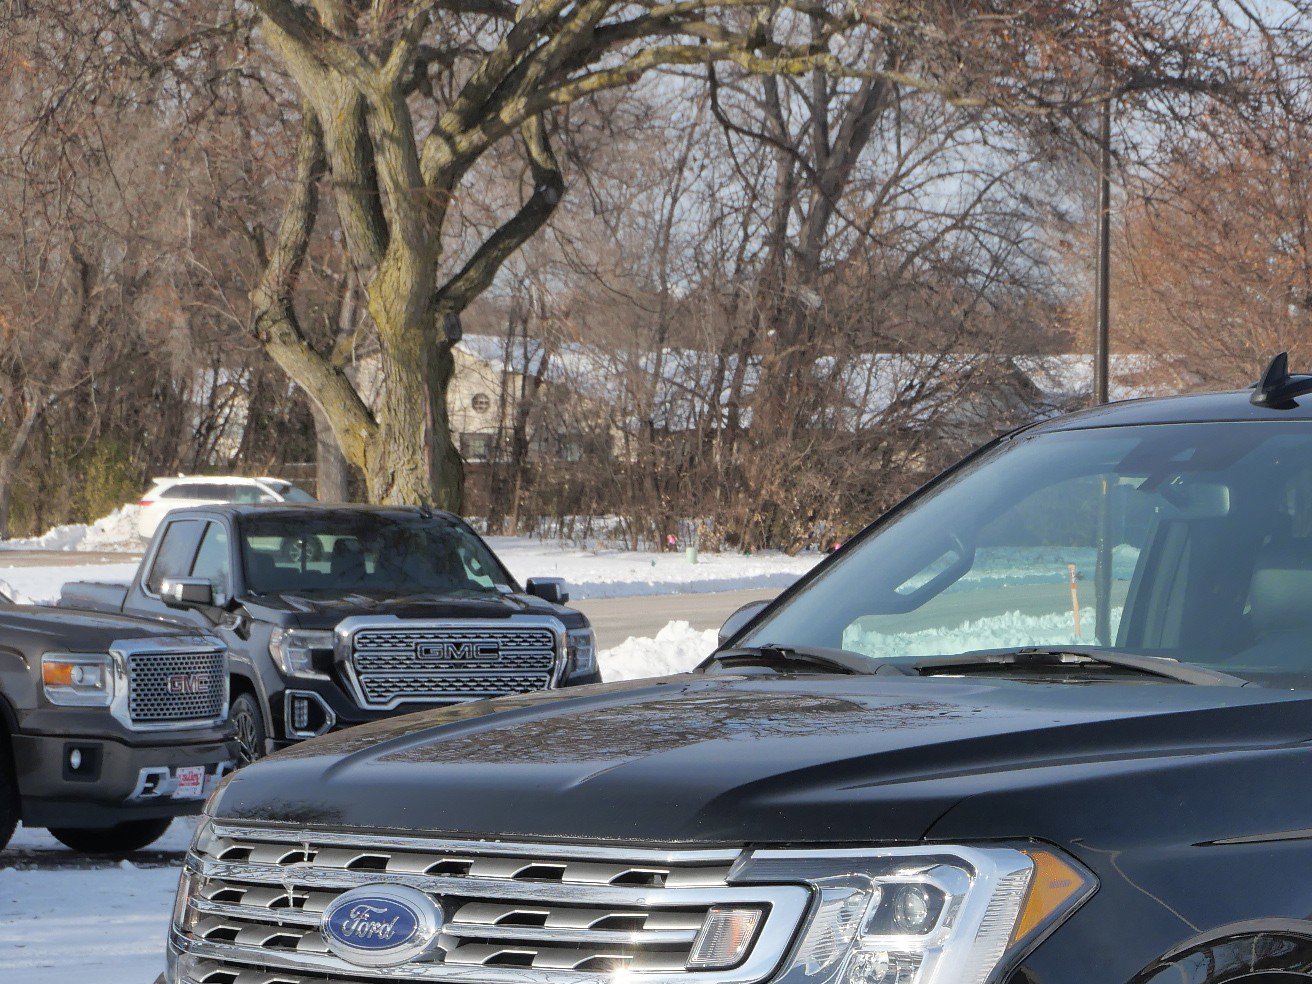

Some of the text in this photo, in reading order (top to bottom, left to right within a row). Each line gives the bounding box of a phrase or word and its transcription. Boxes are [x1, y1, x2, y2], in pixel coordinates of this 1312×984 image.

[417, 642, 499, 660] GMC
[167, 672, 210, 693] GMC
[342, 904, 400, 940] Ford
